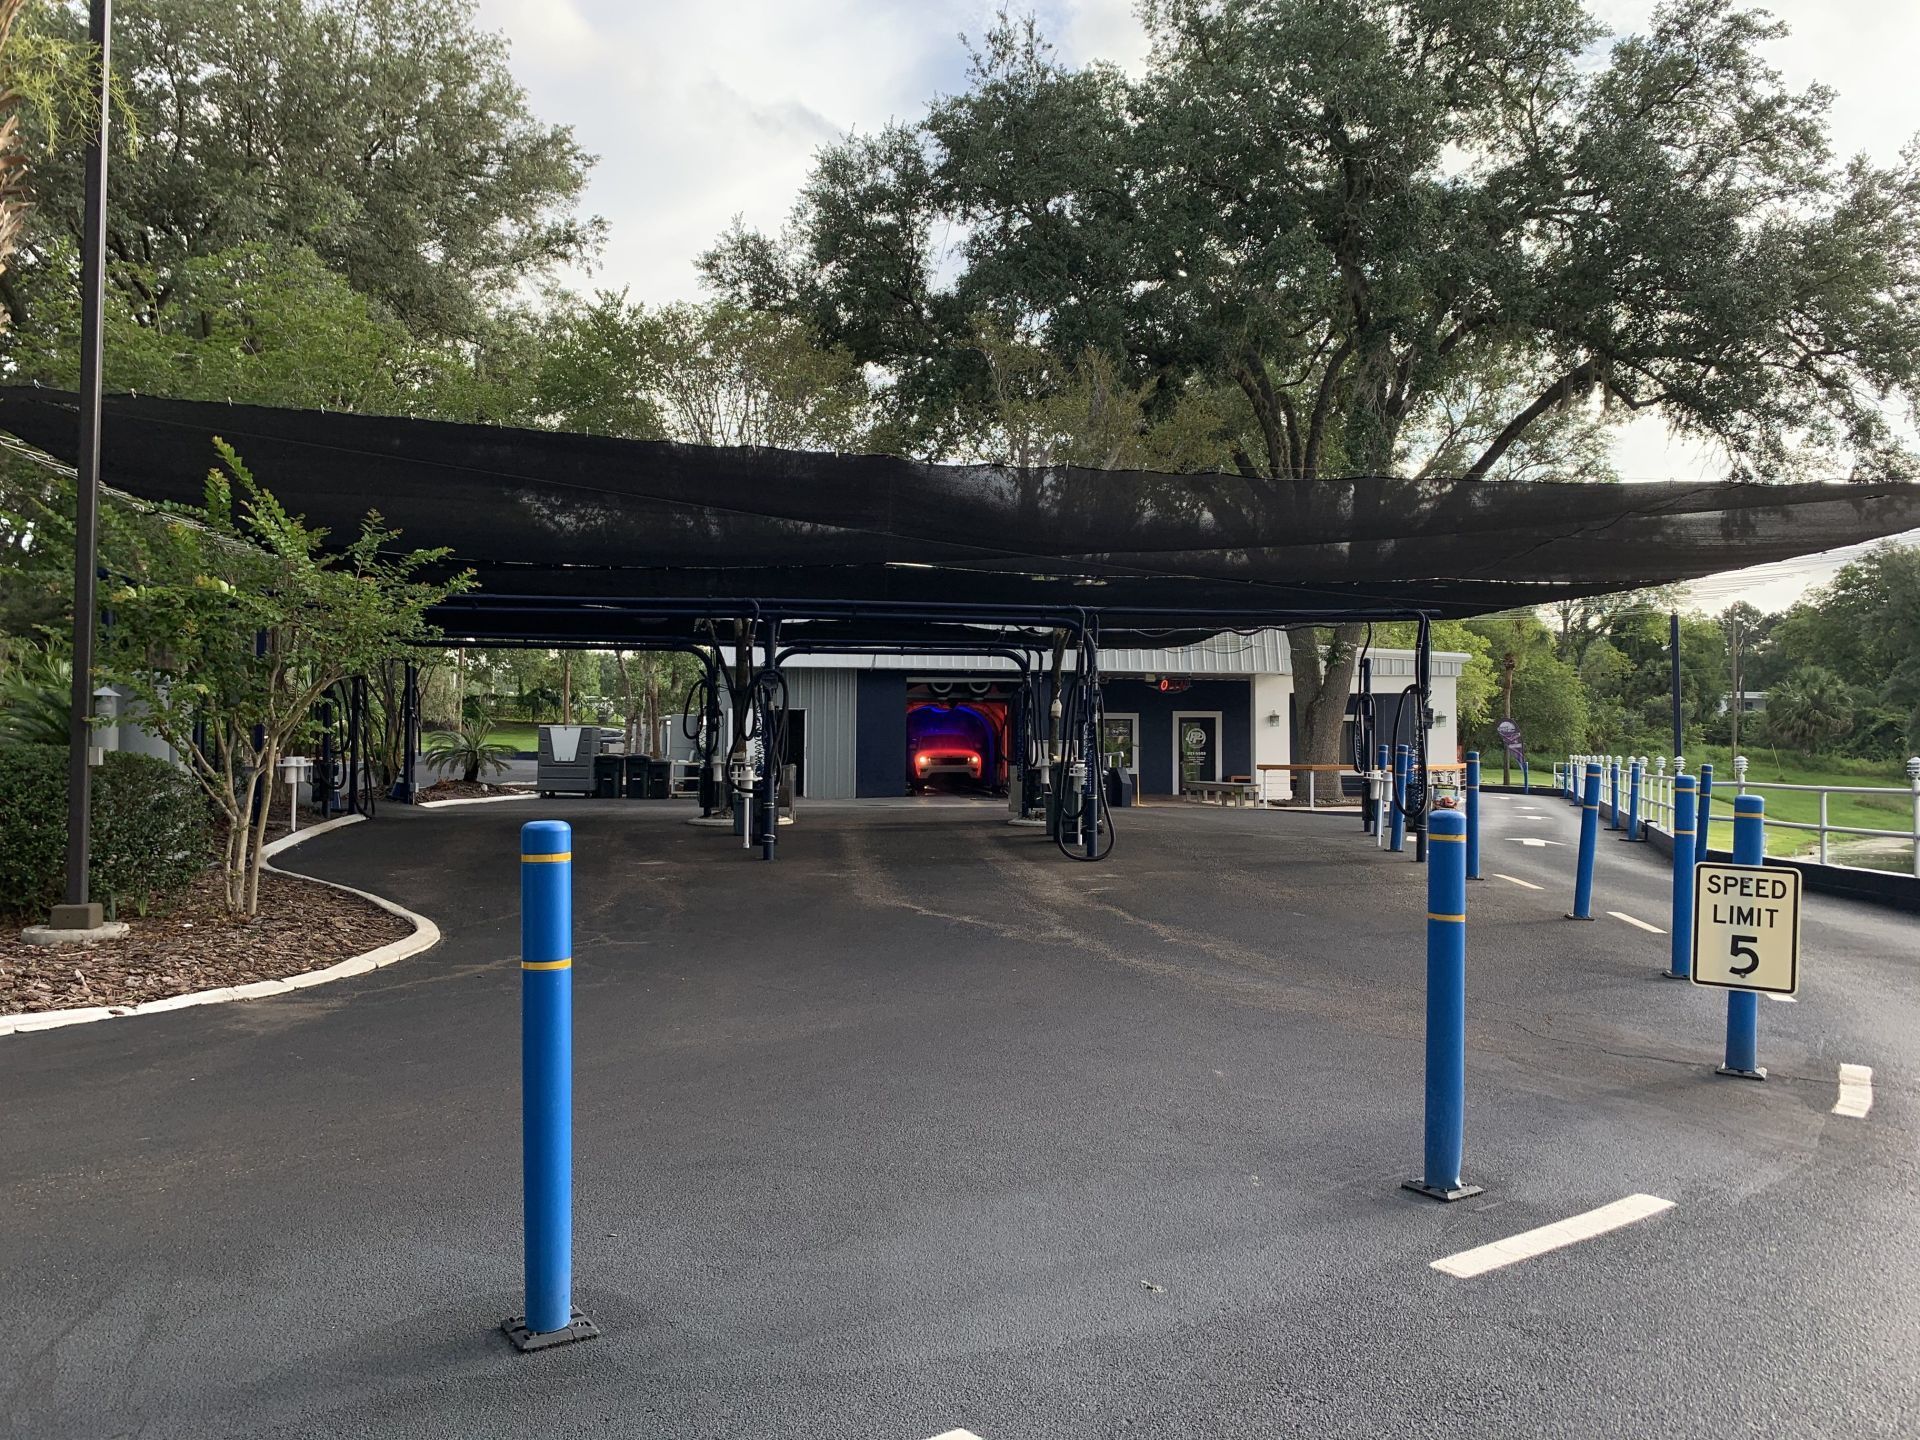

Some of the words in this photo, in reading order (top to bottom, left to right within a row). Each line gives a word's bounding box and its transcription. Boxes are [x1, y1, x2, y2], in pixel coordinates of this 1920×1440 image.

[1707, 874, 1787, 899] SPEED
[1713, 904, 1779, 928] LIMIT
[1729, 934, 1760, 976] 5
